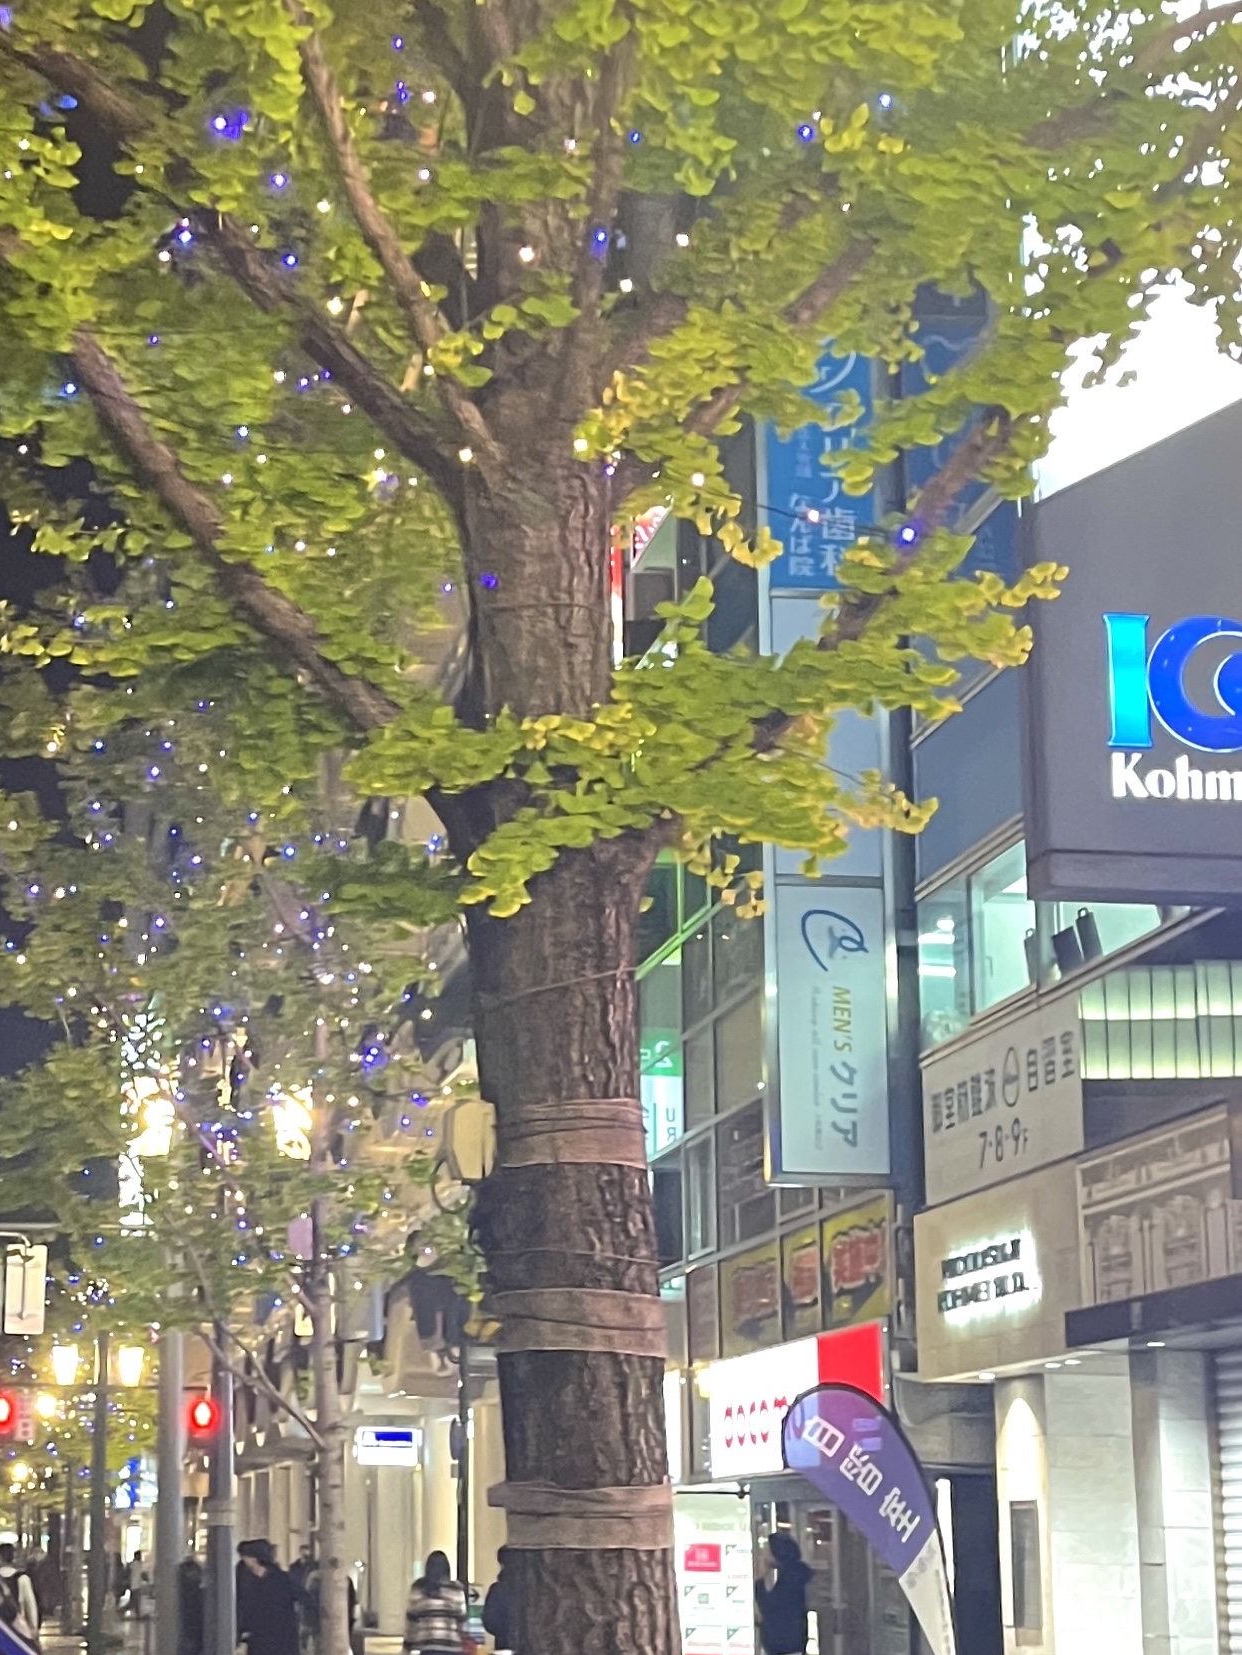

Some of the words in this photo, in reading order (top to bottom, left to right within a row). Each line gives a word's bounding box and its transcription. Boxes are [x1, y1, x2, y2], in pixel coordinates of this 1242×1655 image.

[832, 987, 852, 1052] MEN'S
[830, 1061, 858, 1147] クリア
[803, 1415, 921, 1544] 自習室
